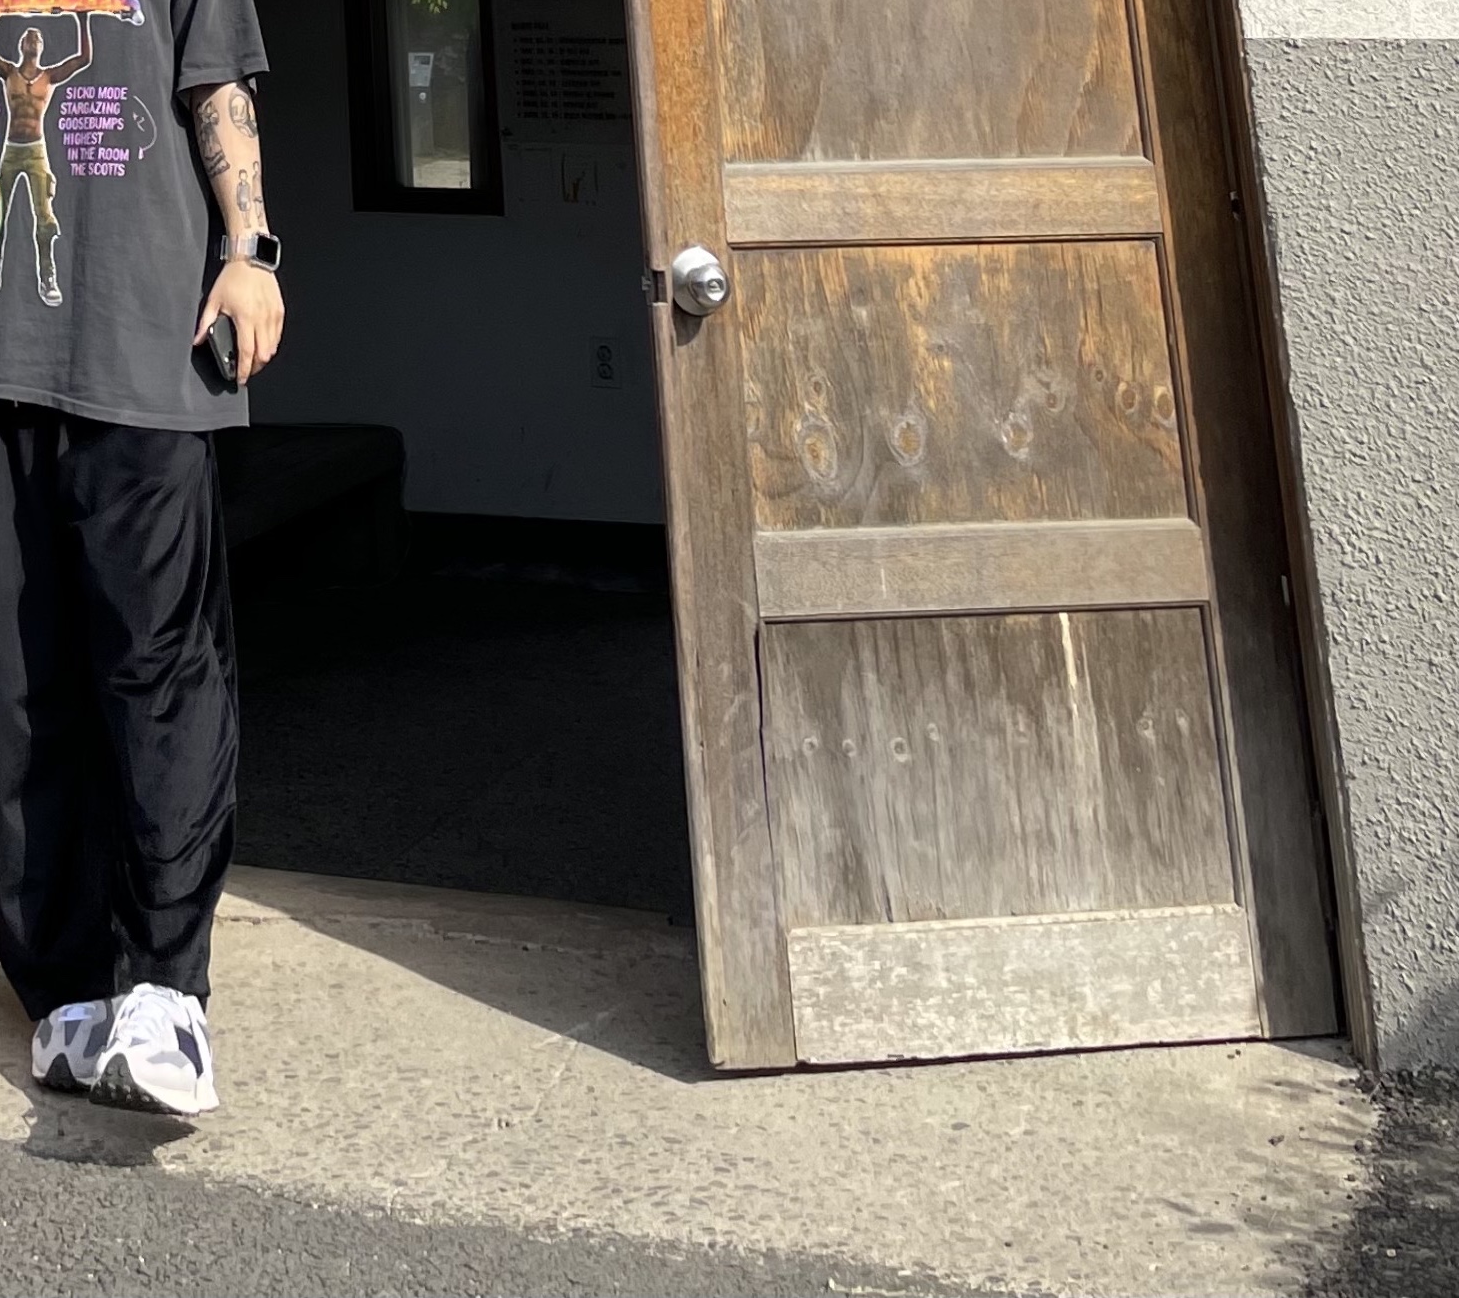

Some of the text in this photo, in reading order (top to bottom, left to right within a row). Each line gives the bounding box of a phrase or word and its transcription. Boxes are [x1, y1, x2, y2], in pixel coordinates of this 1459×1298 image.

[97, 86, 129, 100] MODE
[60, 102, 121, 115] STARGAZING
[58, 117, 125, 130] GOOSEBUMPS
[63, 132, 104, 145] HIGHEST
[67, 148, 79, 160] IN
[98, 147, 130, 161] ROOM
[70, 162, 126, 177] THE SCOTTS
